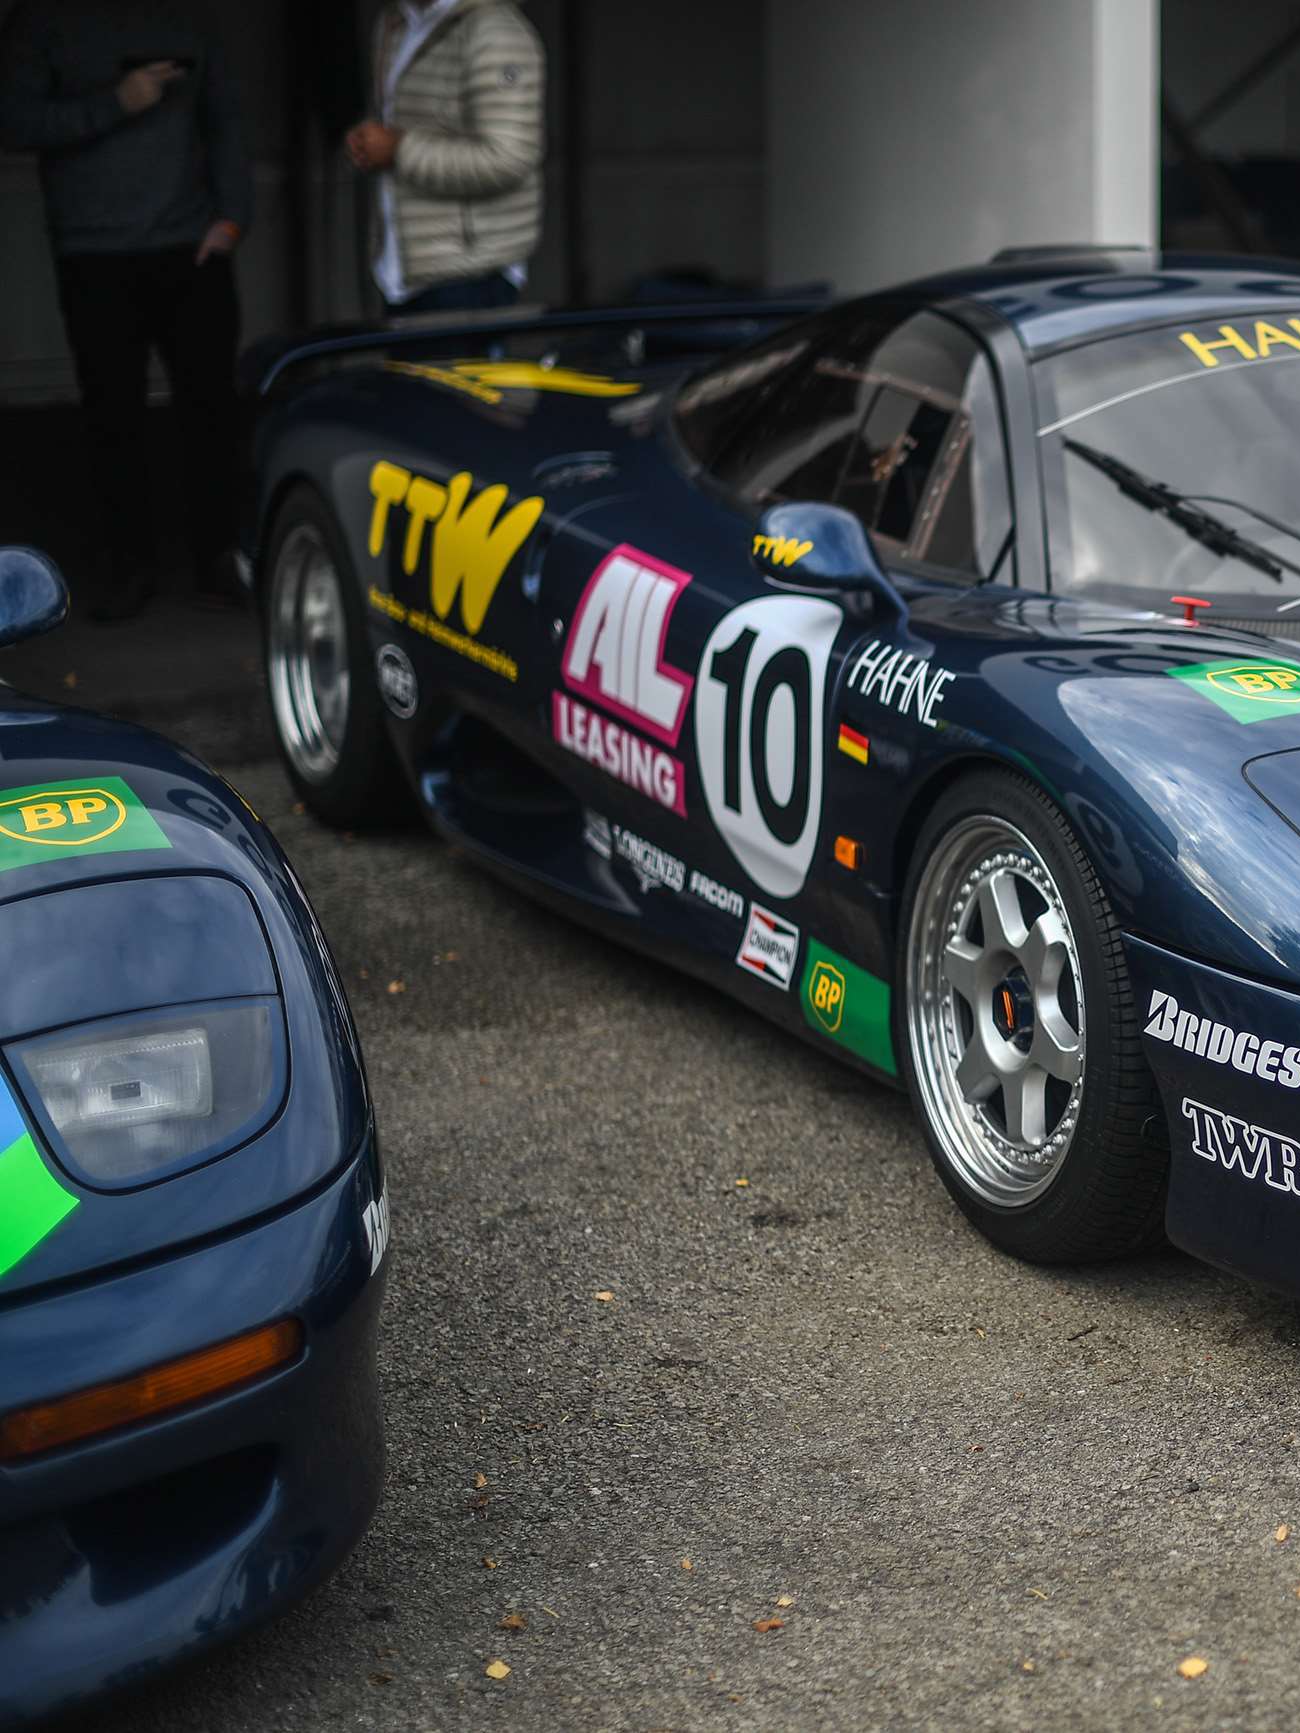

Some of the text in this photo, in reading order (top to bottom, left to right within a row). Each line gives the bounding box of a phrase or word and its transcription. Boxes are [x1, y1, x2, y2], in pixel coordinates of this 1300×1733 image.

[369, 460, 545, 635] TTW
[753, 534, 814, 567] TTW
[847, 640, 956, 729] HAHNE
[1229, 671, 1298, 694] BP
[558, 697, 677, 808] LEASING
[710, 626, 811, 847] 10
[19, 797, 107, 833] BP
[749, 929, 793, 966] CHAMPION
[815, 974, 841, 1014] BP
